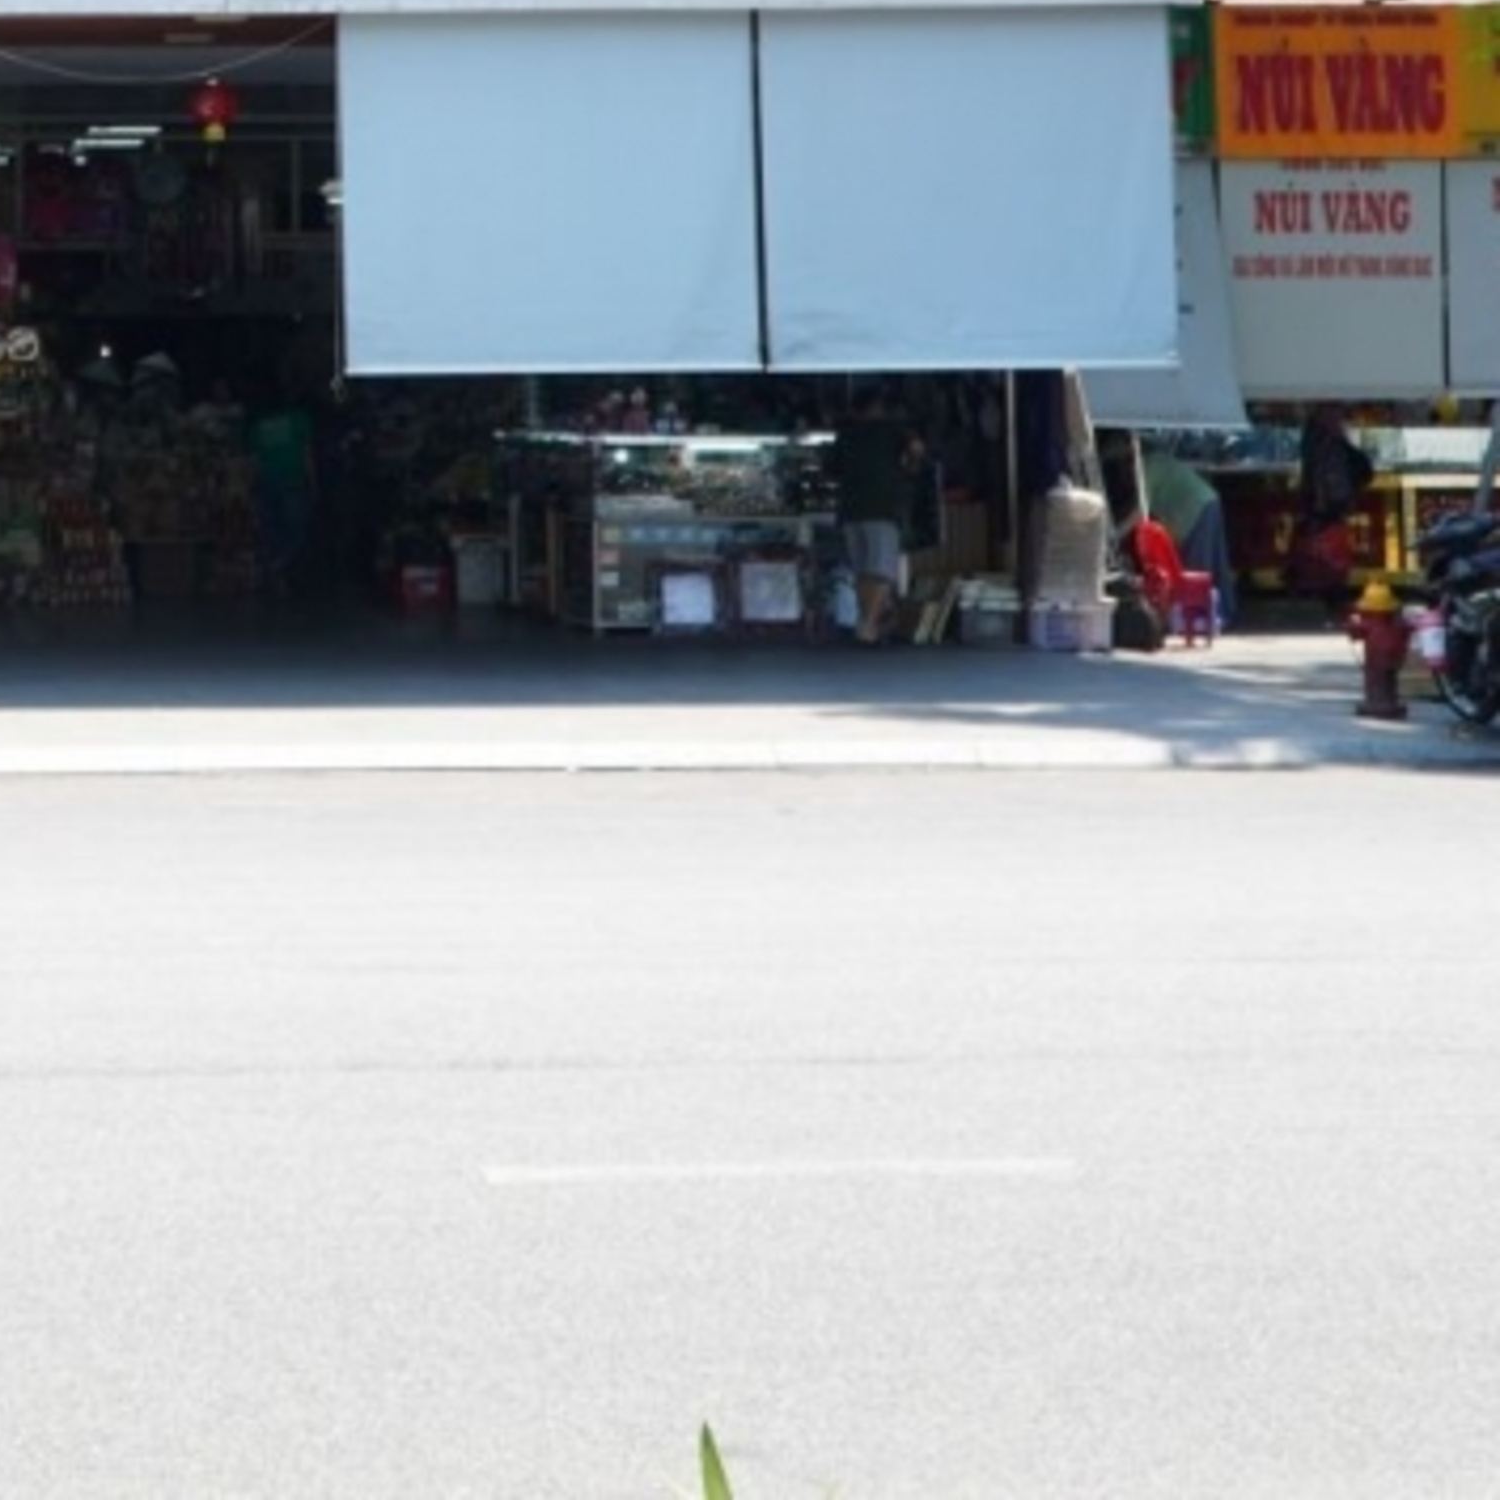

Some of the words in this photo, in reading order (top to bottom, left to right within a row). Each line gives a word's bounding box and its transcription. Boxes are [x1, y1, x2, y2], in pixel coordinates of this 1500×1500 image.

[1235, 34, 1316, 135] NÚI
[1325, 34, 1446, 135] VÀNG
[1253, 180, 1312, 234] NÚI
[1321, 180, 1412, 234] VÀNG
